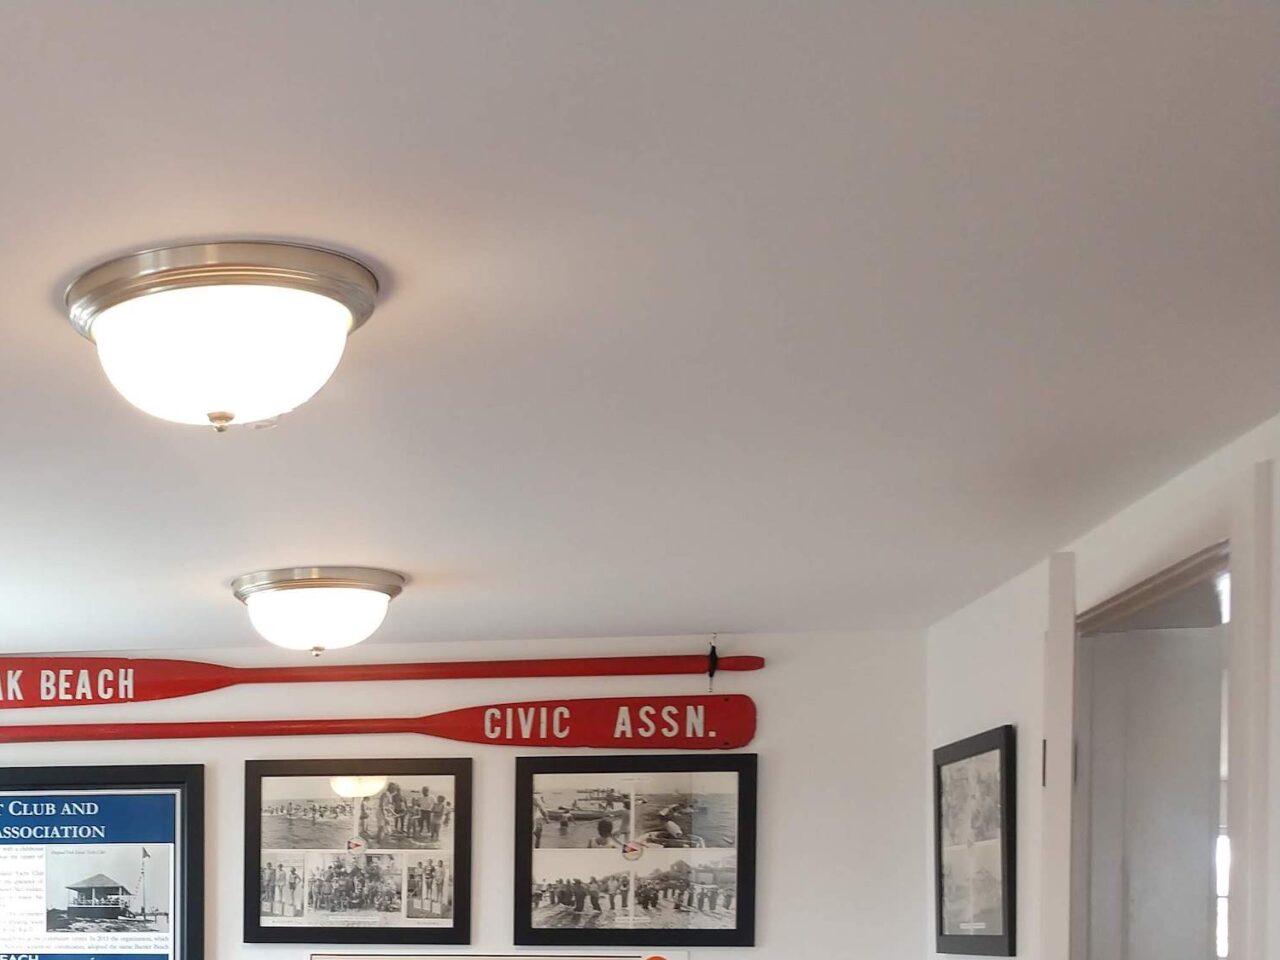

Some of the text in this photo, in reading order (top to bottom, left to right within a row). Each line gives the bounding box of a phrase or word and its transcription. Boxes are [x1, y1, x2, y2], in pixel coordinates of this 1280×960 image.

[40, 668, 134, 701] BEACH
[484, 705, 717, 739] CIVIC ASSN.
[8, 800, 57, 816] CLUB
[60, 802, 99, 816] AND
